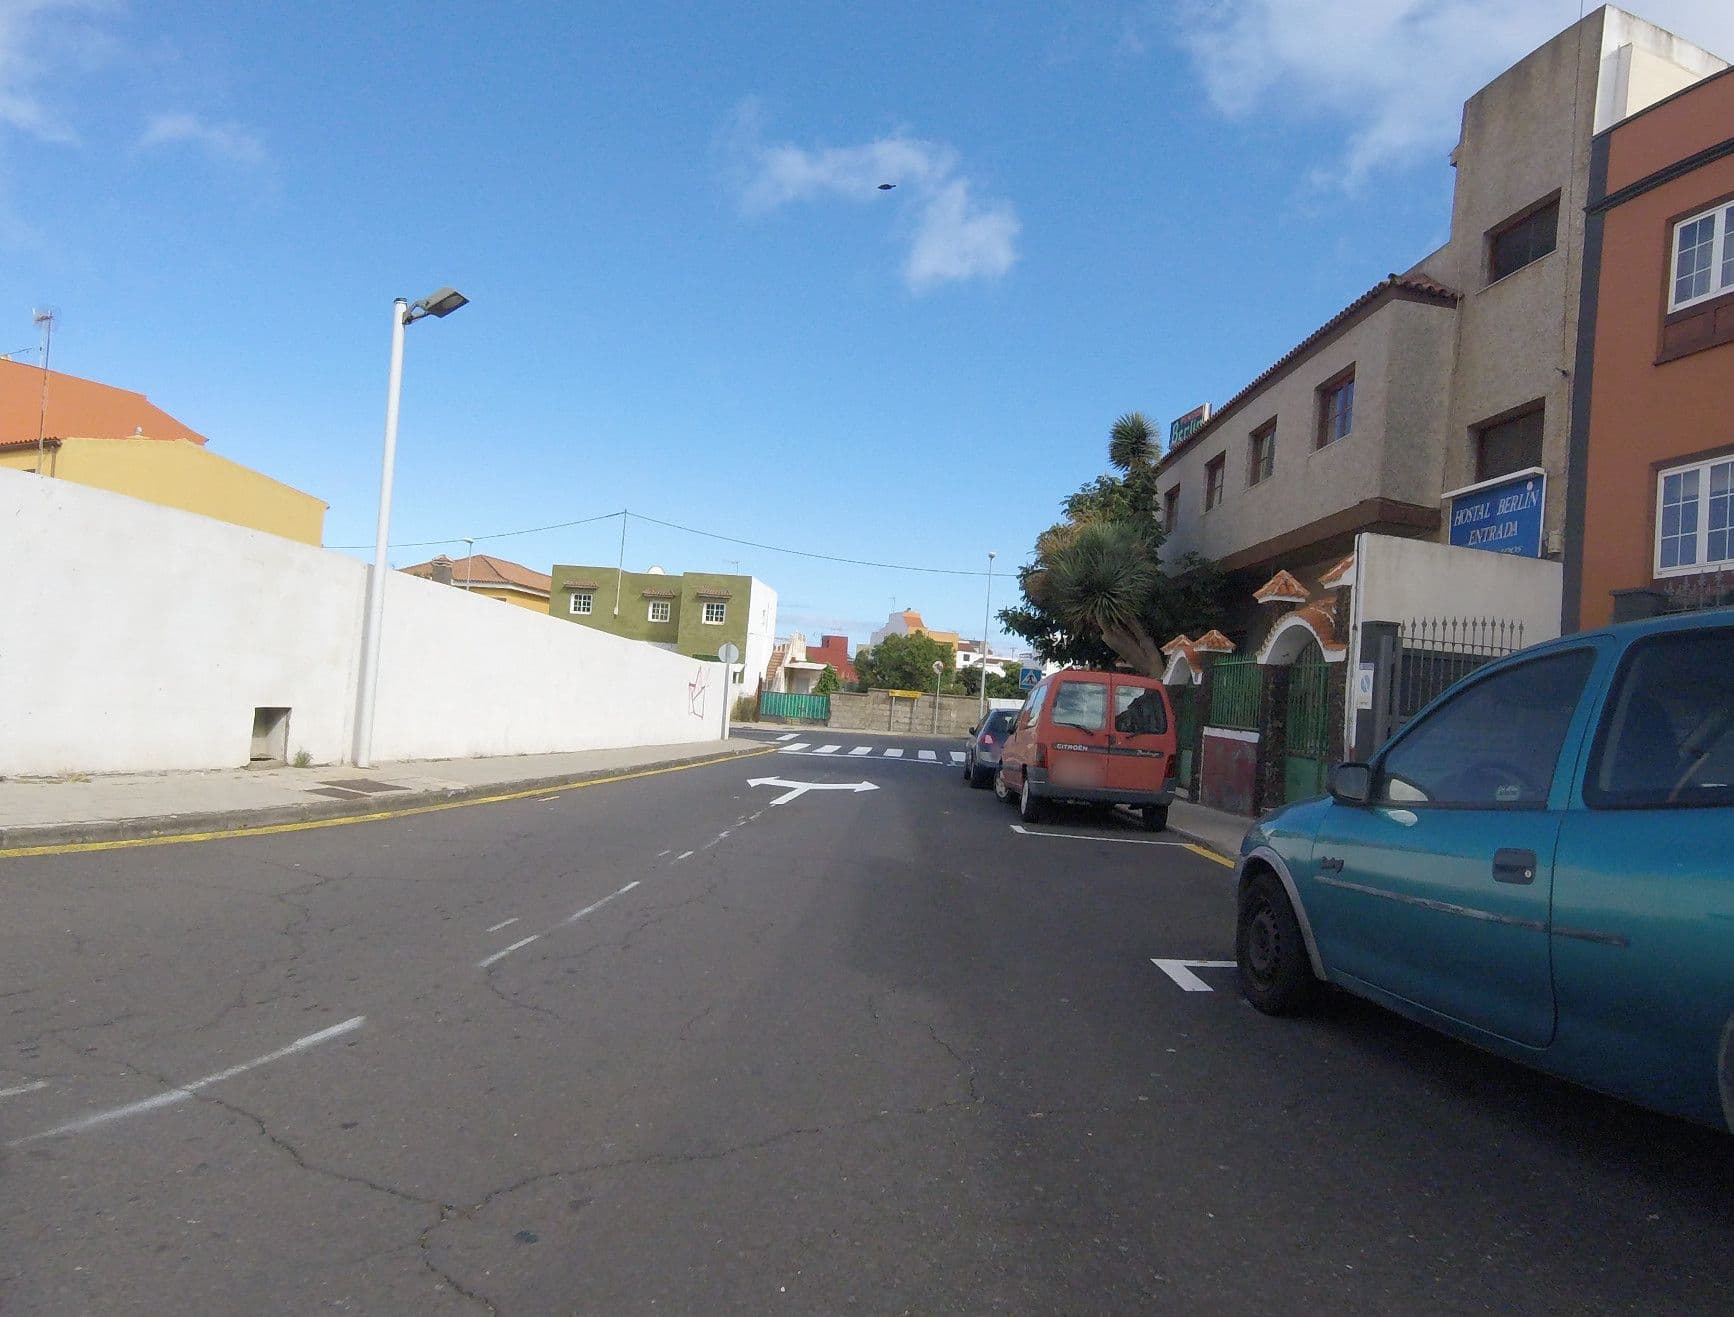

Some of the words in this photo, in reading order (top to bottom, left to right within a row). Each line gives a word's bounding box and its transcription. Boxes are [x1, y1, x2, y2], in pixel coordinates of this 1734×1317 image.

[1453, 502, 1491, 527] HOSTAL
[1496, 489, 1540, 516] BERLIN
[1468, 520, 1518, 546] ENTRADA
